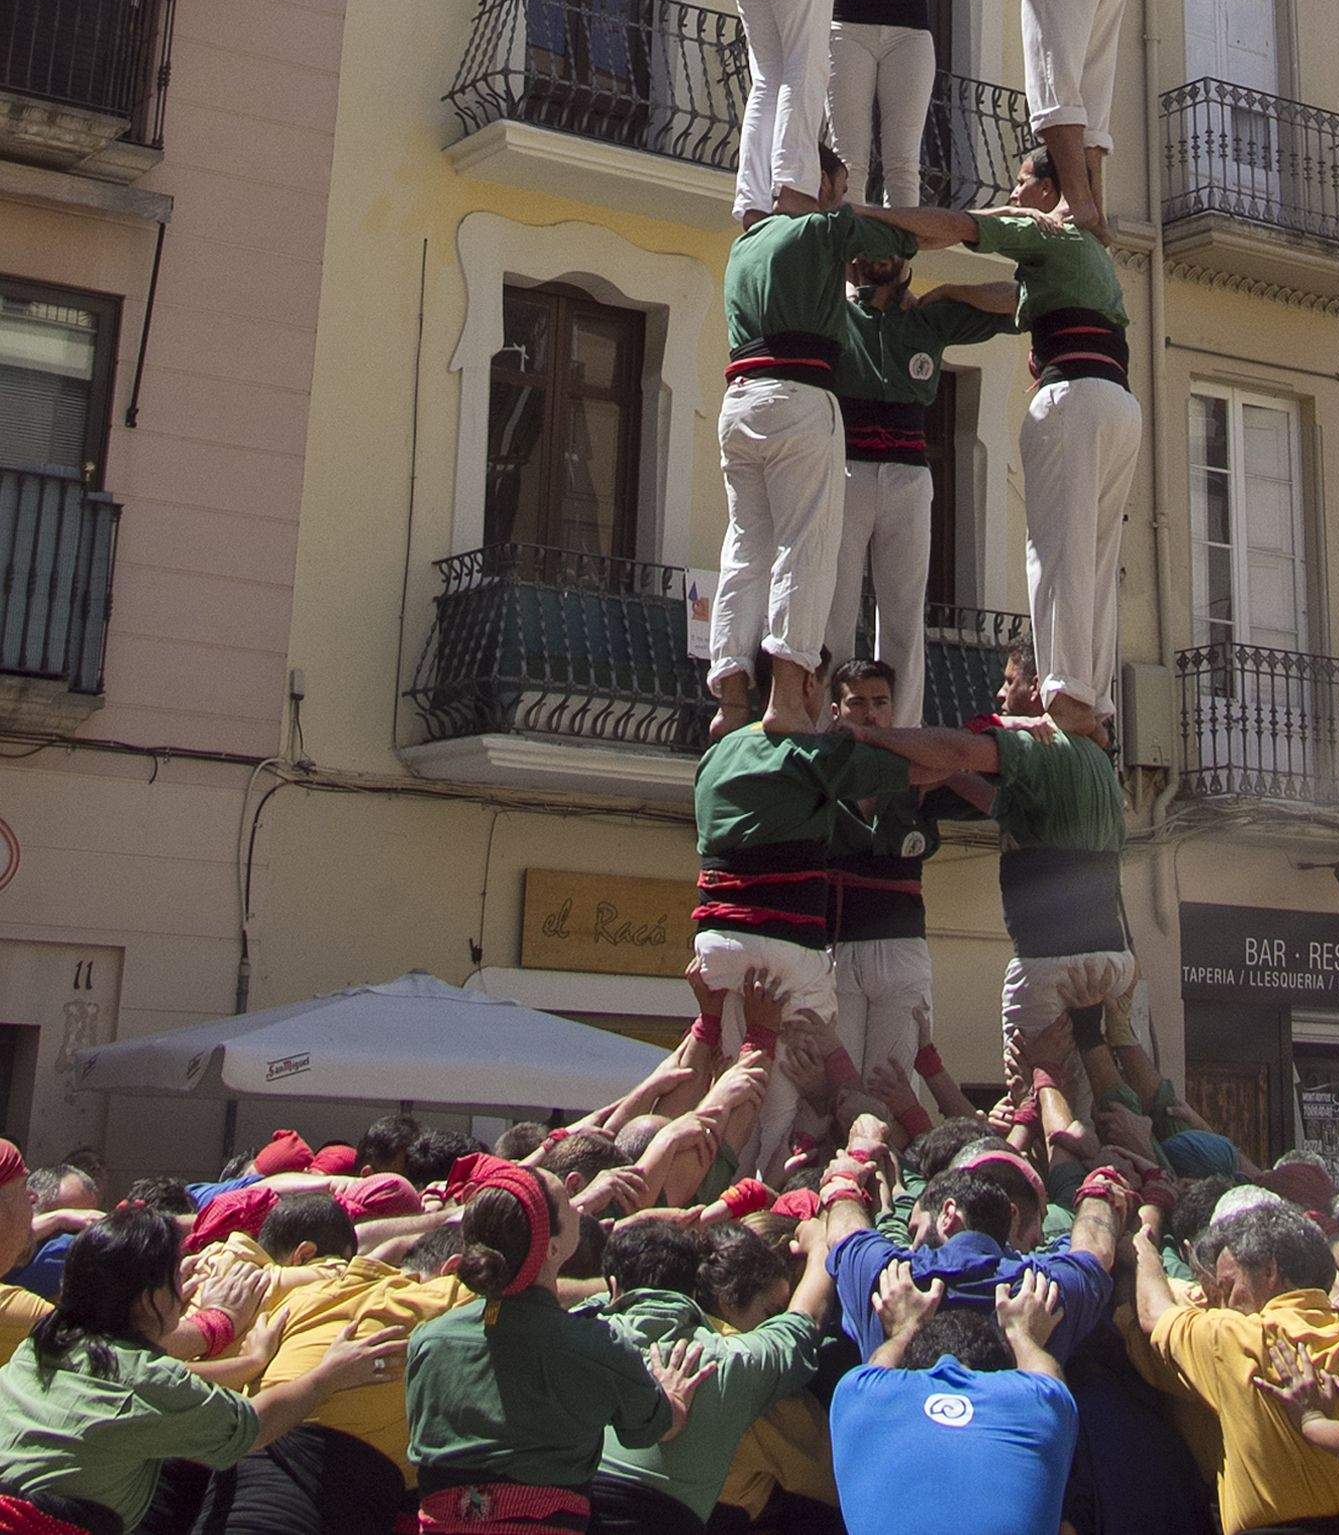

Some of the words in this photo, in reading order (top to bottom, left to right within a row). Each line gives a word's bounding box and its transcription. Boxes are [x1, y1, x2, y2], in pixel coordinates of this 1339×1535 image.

[542, 897, 573, 938] el
[593, 901, 668, 946] Racó
[1246, 938, 1286, 967] BAR
[73, 961, 94, 990] 11
[1182, 966, 1235, 985] TAPERIA
[1250, 971, 1324, 990] LLESQUERIA
